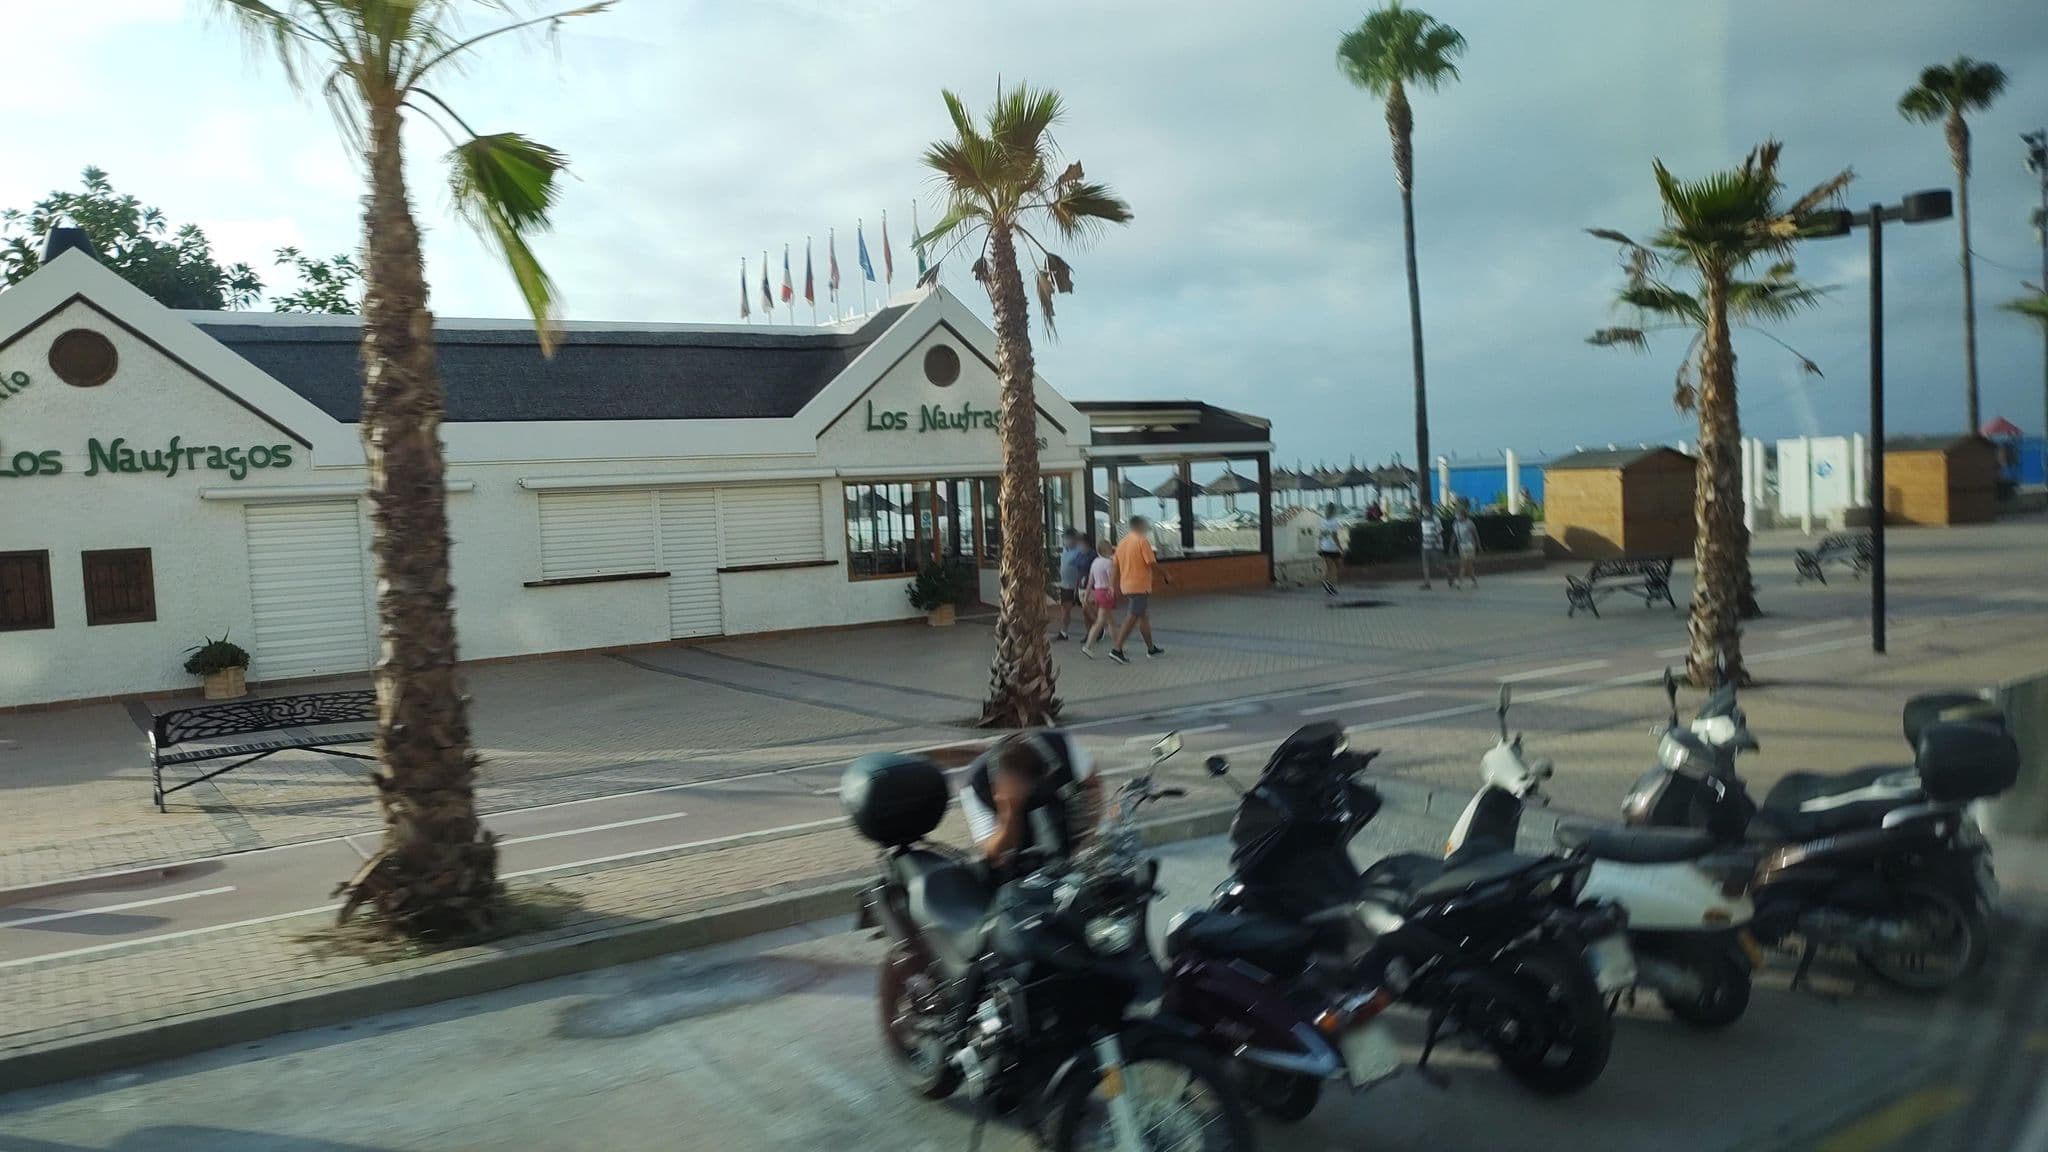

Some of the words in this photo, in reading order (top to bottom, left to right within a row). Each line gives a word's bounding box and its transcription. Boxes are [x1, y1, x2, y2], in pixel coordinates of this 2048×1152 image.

[866, 399, 908, 432] Los
[918, 401, 1003, 435] Naufrag
[84, 435, 293, 481] Naufragos
